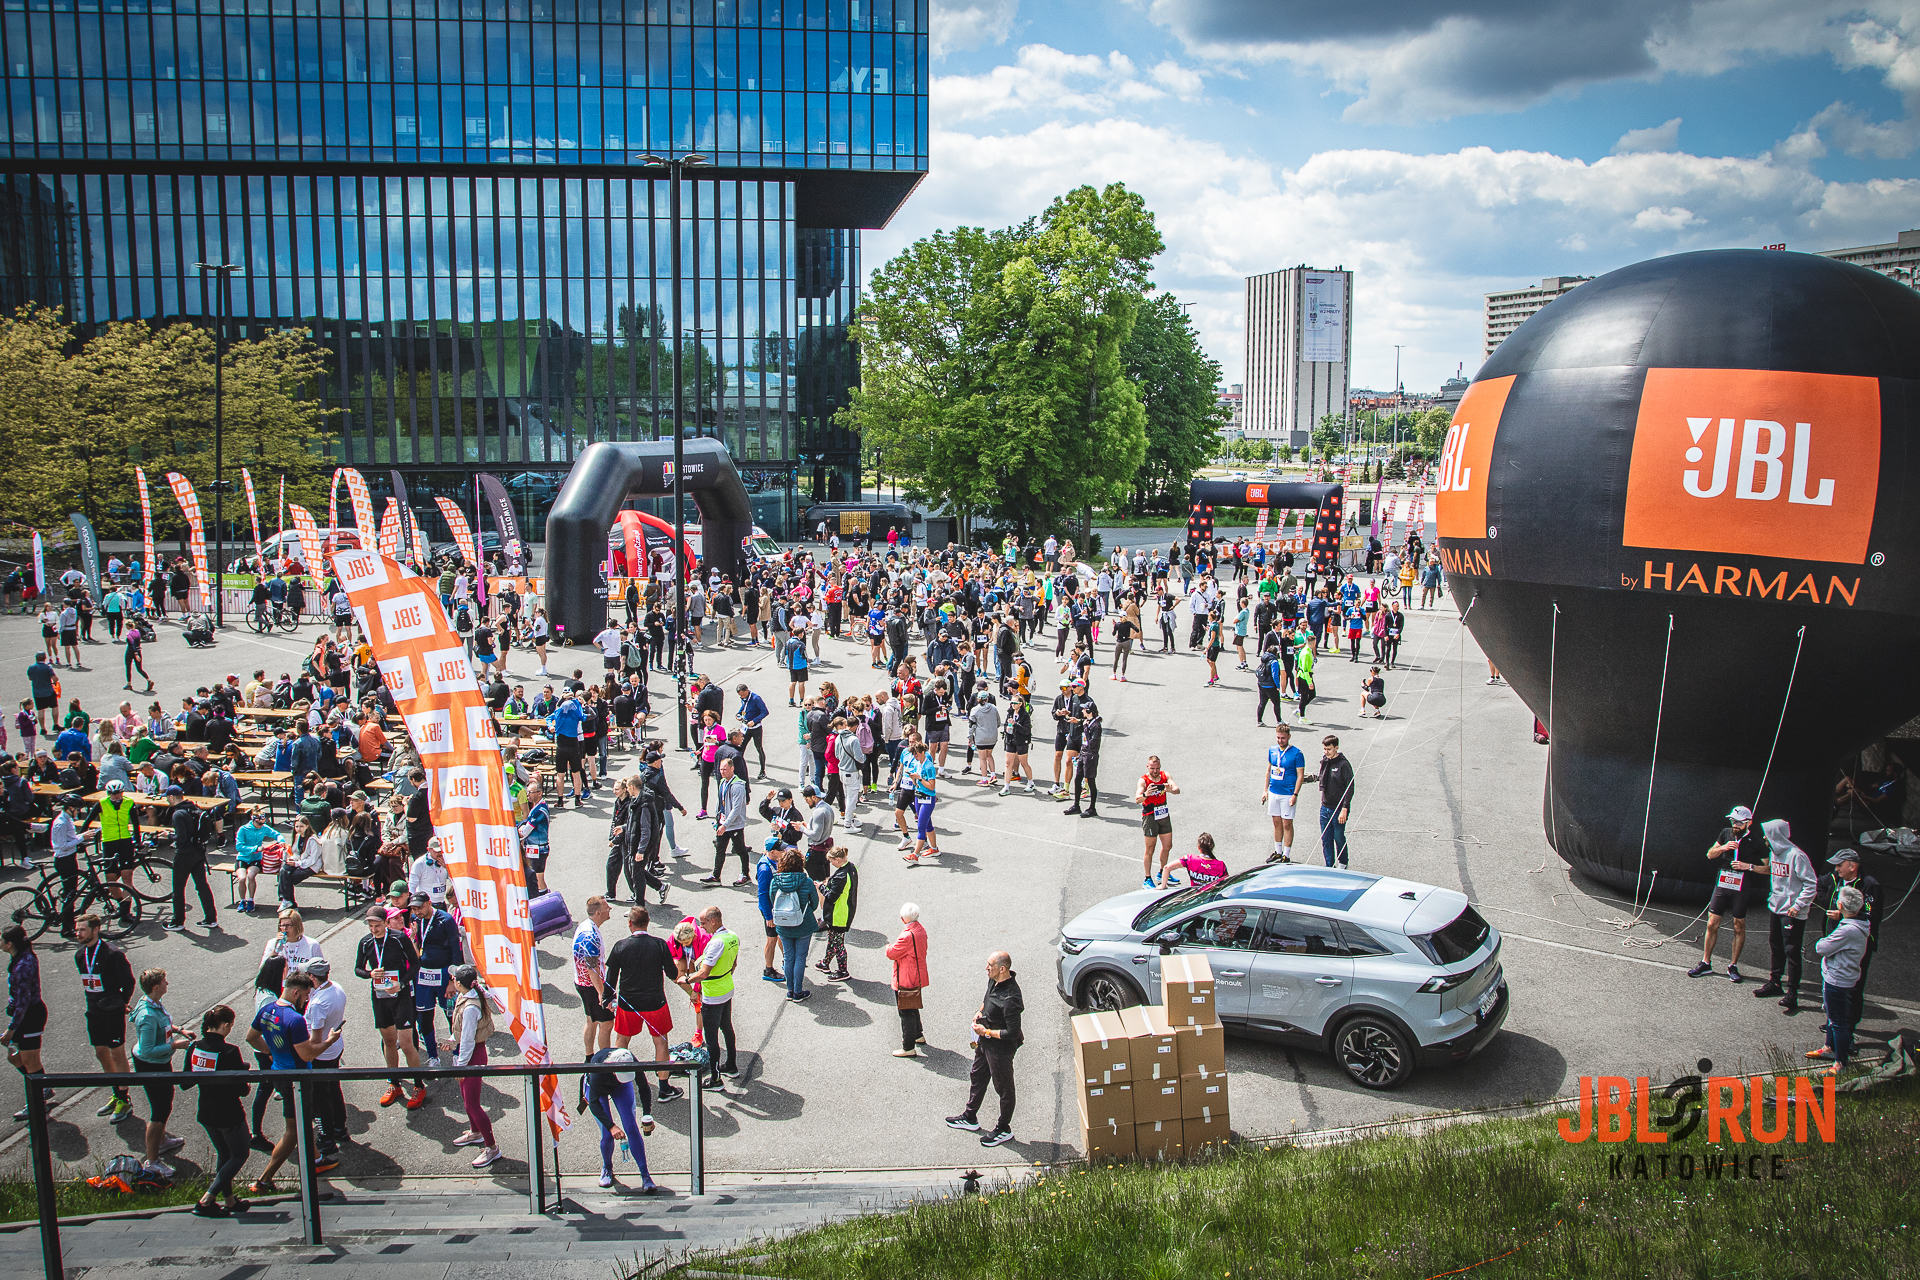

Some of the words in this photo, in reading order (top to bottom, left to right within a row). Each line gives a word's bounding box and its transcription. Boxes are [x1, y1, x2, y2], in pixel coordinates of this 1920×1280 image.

[1682, 417, 1836, 507] JBL
[1250, 488, 1264, 498] JBL
[1621, 572, 1639, 591] by
[1643, 560, 1861, 607] HARMAN
[1215, 978, 1242, 987] Renault
